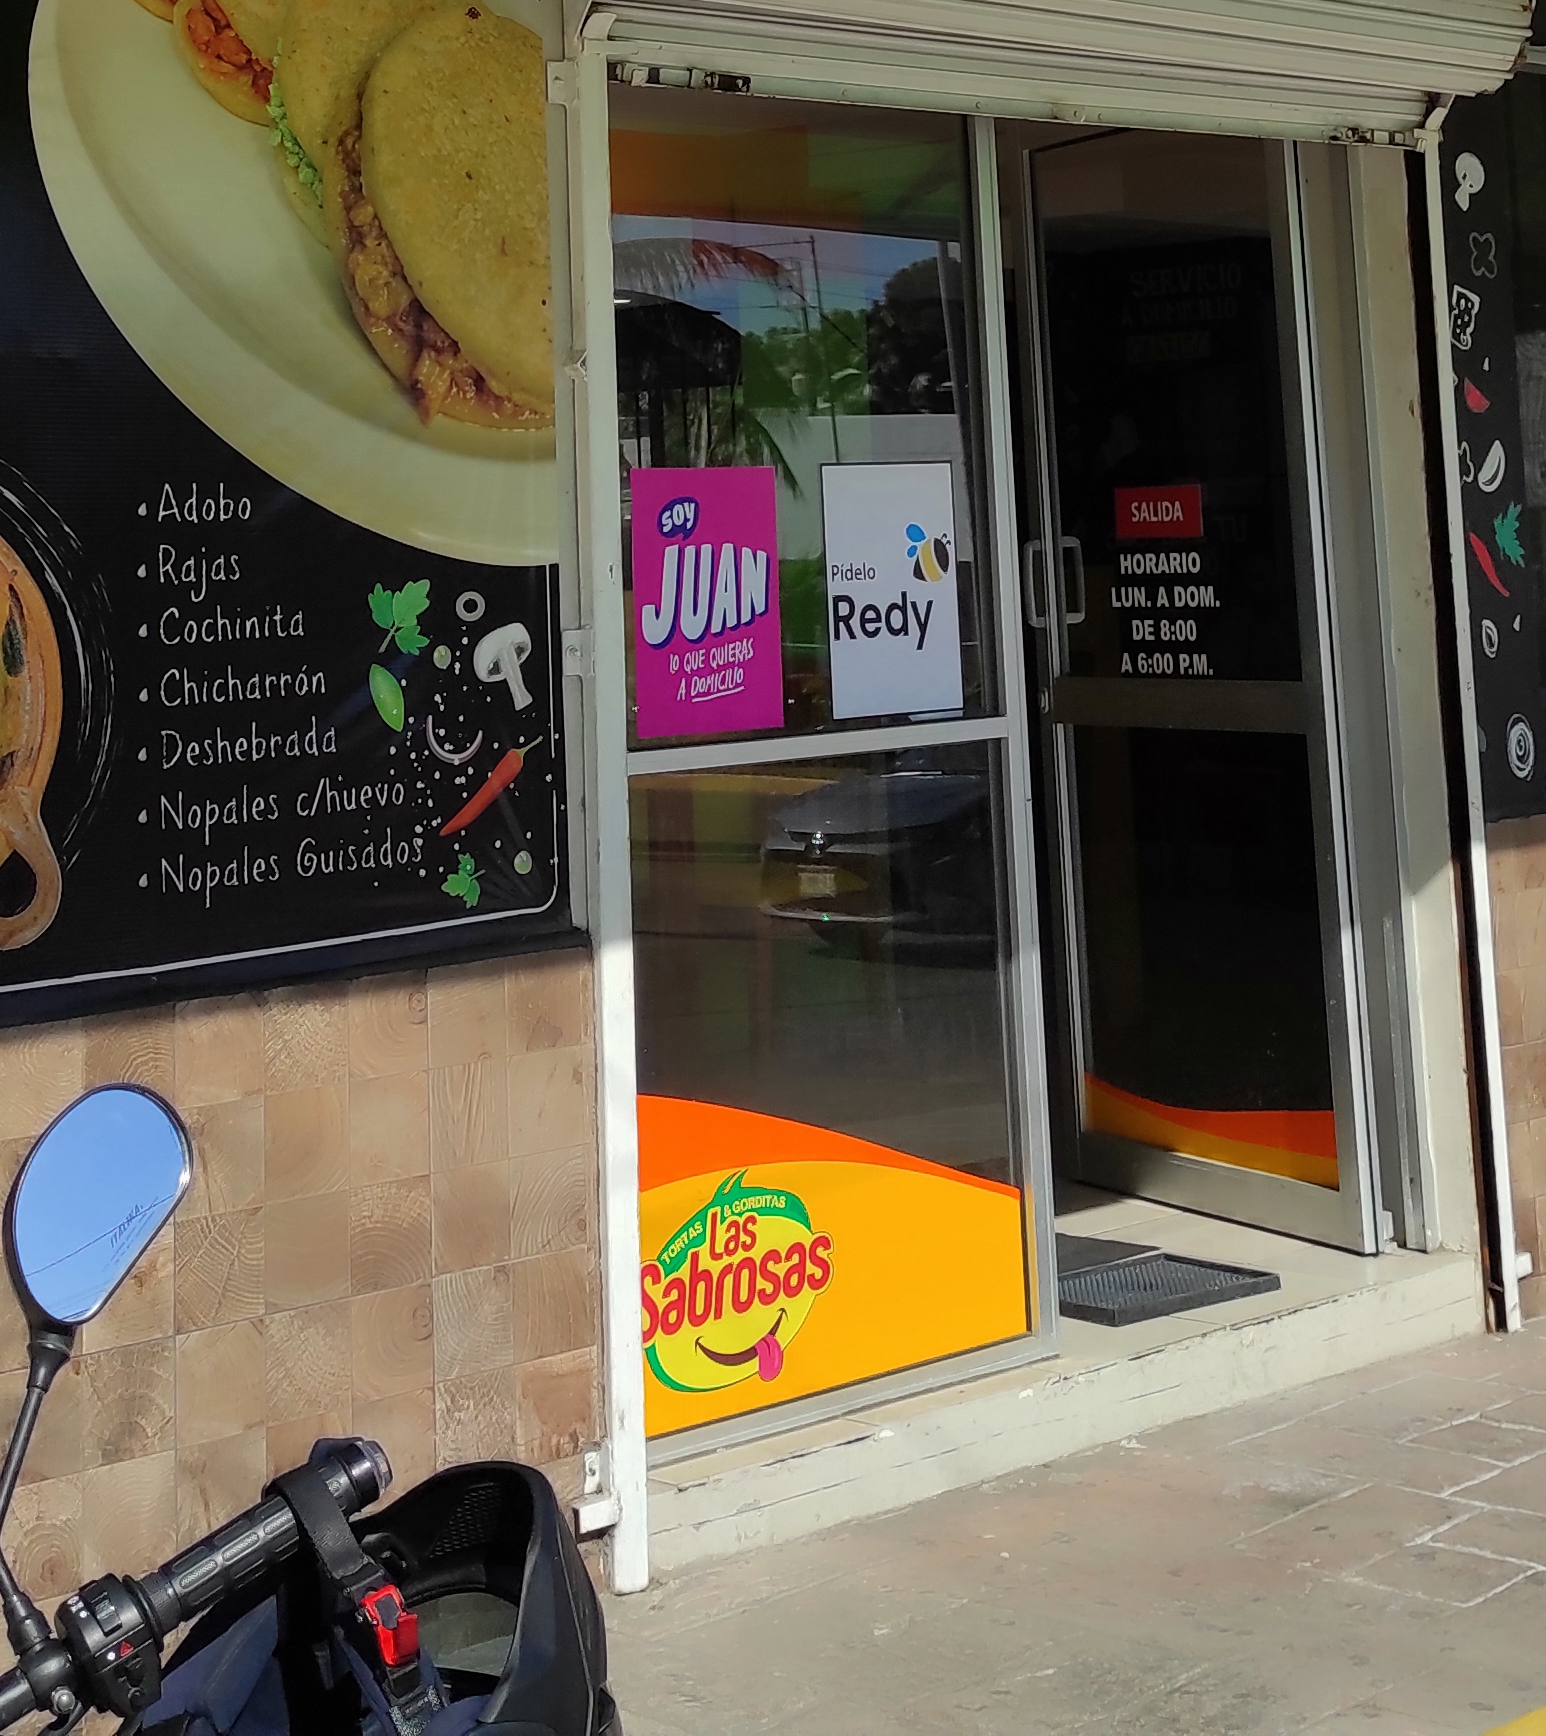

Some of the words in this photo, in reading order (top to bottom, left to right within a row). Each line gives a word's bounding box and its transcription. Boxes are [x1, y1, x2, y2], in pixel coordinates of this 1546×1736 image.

[157, 482, 252, 524] Adobo
[1131, 500, 1184, 524] SALIDA
[158, 543, 241, 603] Rajas
[831, 561, 877, 583] Pídelo
[1120, 551, 1202, 575] HORARIO
[641, 542, 768, 646] JUAN
[1111, 585, 1153, 610] LUN.
[1157, 585, 1170, 609] A
[1173, 584, 1221, 609] DOM.
[159, 606, 306, 646] Cochinita
[832, 590, 934, 651] Redy
[1132, 619, 1156, 642] DE
[1159, 618, 1198, 643] 8:00
[683, 648, 706, 674] QUE
[709, 636, 755, 667] QUIERAS
[1121, 653, 1133, 675] A
[1137, 652, 1175, 676] 6:00
[1179, 652, 1215, 677] P.M.
[159, 665, 327, 707] Chicharrón
[676, 680, 687, 701] A
[690, 666, 745, 695] DOMICILIO
[160, 715, 338, 769] Deshebrada
[160, 784, 279, 846] Nopales
[296, 776, 406, 818] c/huevo
[161, 845, 280, 909] Nopales
[296, 827, 424, 878] Guisados
[660, 1220, 704, 1265] TORTAS
[732, 1193, 787, 1214] GORDITAS
[708, 1210, 758, 1262] Las
[641, 1234, 833, 1344] Sabrosas
